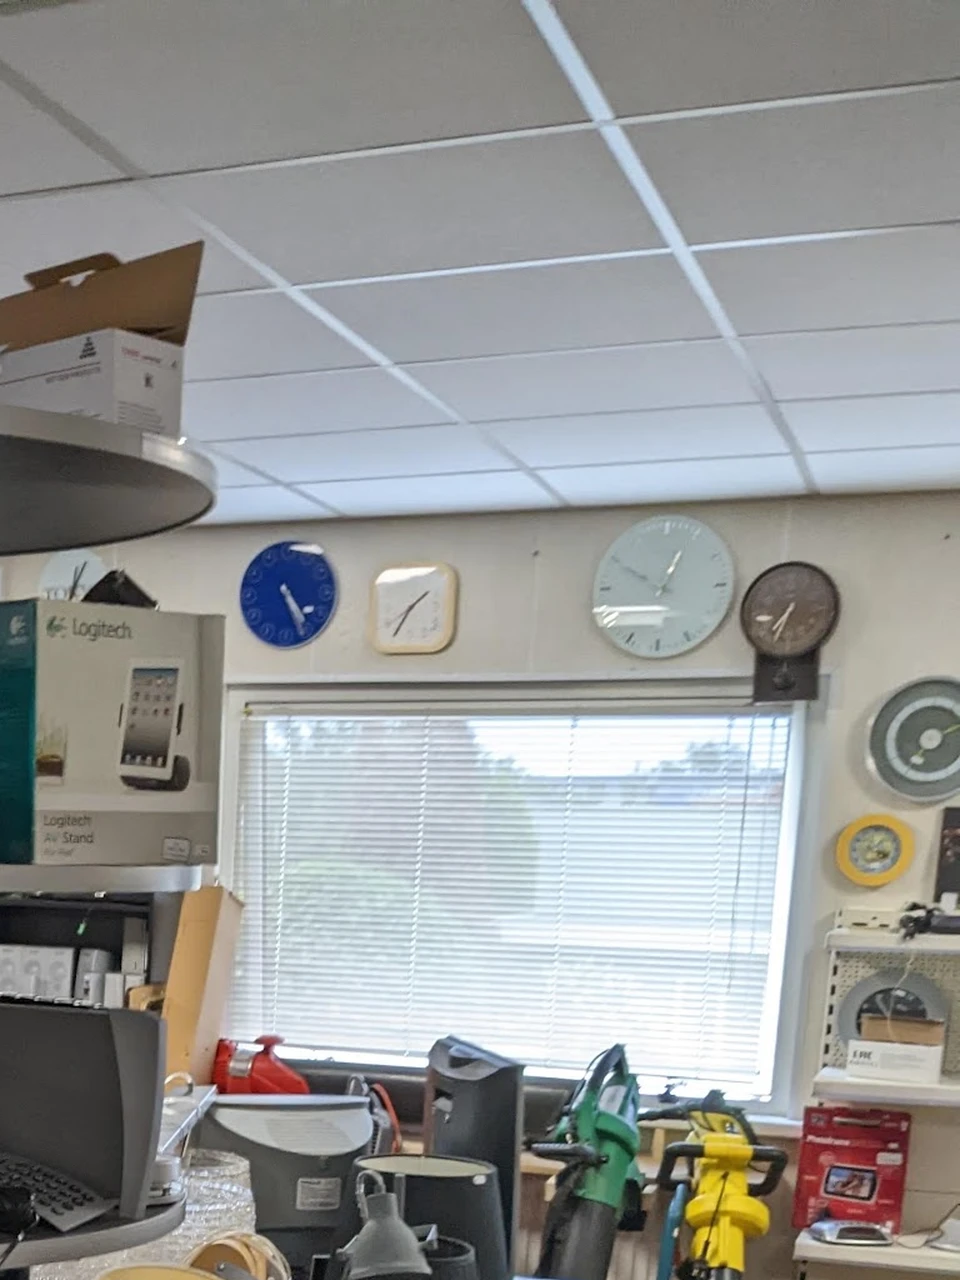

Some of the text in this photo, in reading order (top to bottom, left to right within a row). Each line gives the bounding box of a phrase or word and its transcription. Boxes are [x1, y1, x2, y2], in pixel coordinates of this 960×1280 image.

[72, 619, 132, 641] Logitech
[44, 814, 91, 828] Logitech
[62, 831, 94, 844] Stand
